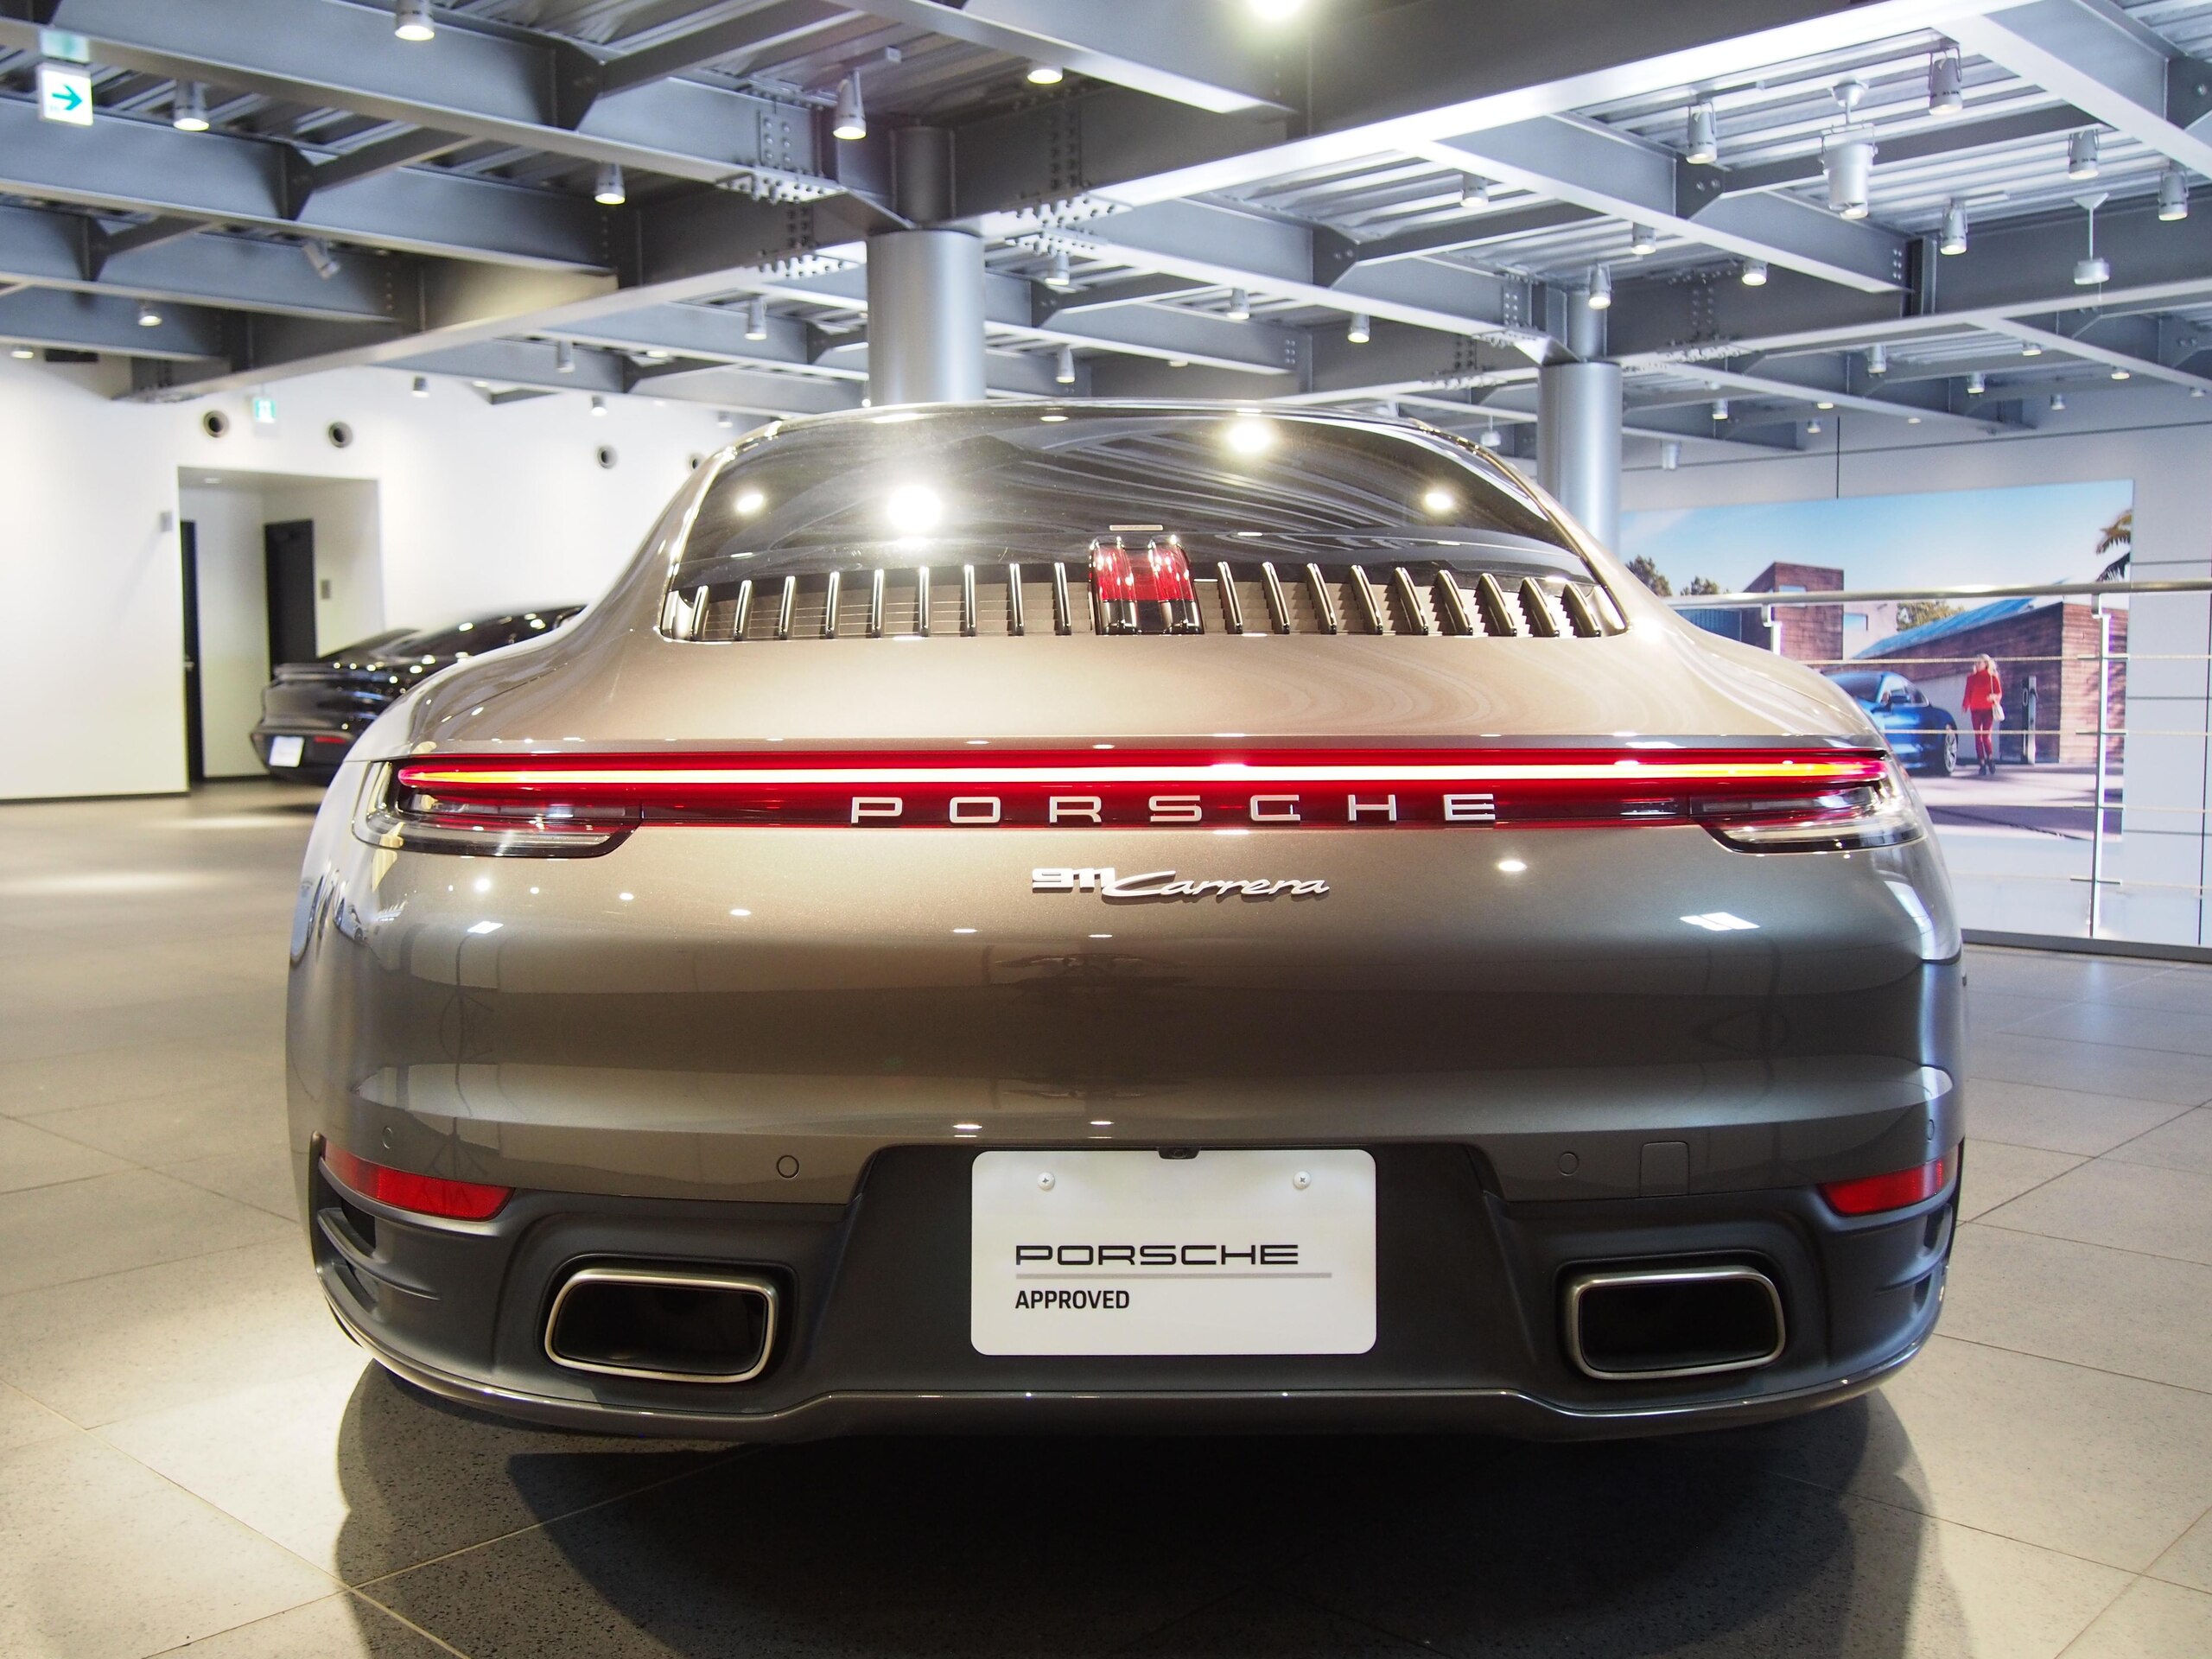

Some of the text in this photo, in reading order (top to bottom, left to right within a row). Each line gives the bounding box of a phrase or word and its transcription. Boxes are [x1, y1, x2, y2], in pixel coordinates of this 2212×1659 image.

[850, 793, 1496, 824] PORSCHE
[1032, 867, 1331, 897] 911 Carrera
[1015, 1244, 1299, 1266] PORSCHE
[1014, 1290, 1130, 1310] APPROVED
